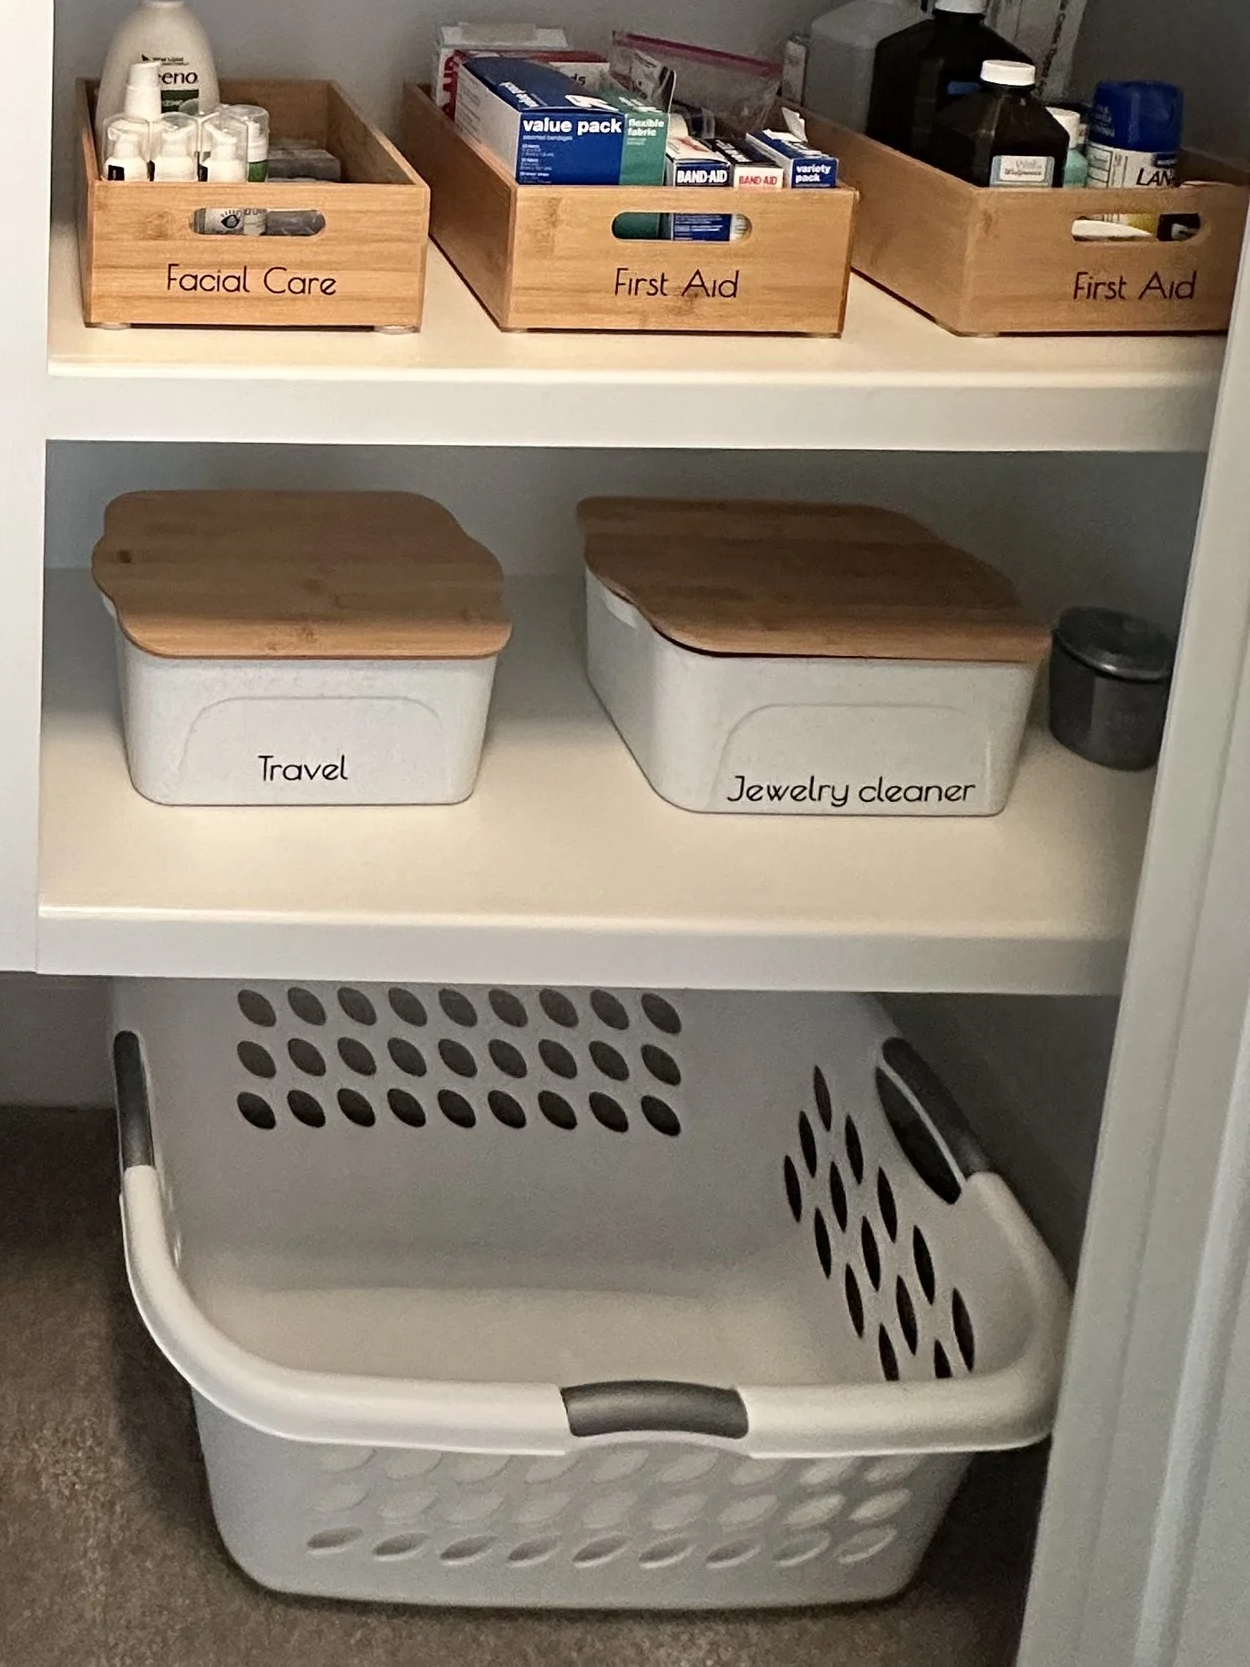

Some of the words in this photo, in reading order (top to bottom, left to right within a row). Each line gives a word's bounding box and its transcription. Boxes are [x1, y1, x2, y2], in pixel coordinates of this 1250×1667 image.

[523, 117, 572, 133] value
[577, 118, 622, 136] pack
[627, 128, 657, 137] fabric
[628, 118, 665, 128] flexible
[677, 169, 729, 184] BAND-AID
[795, 165, 831, 176] variety
[795, 173, 821, 184] pack
[166, 263, 250, 294] Facial
[263, 266, 337, 296] Care
[614, 267, 669, 297] First
[682, 269, 739, 299] Aid
[1073, 270, 1127, 301] First
[1138, 270, 1197, 301] Aid
[257, 754, 349, 783] Travel
[726, 776, 850, 807] Jewelry
[858, 776, 976, 804] cleaner
